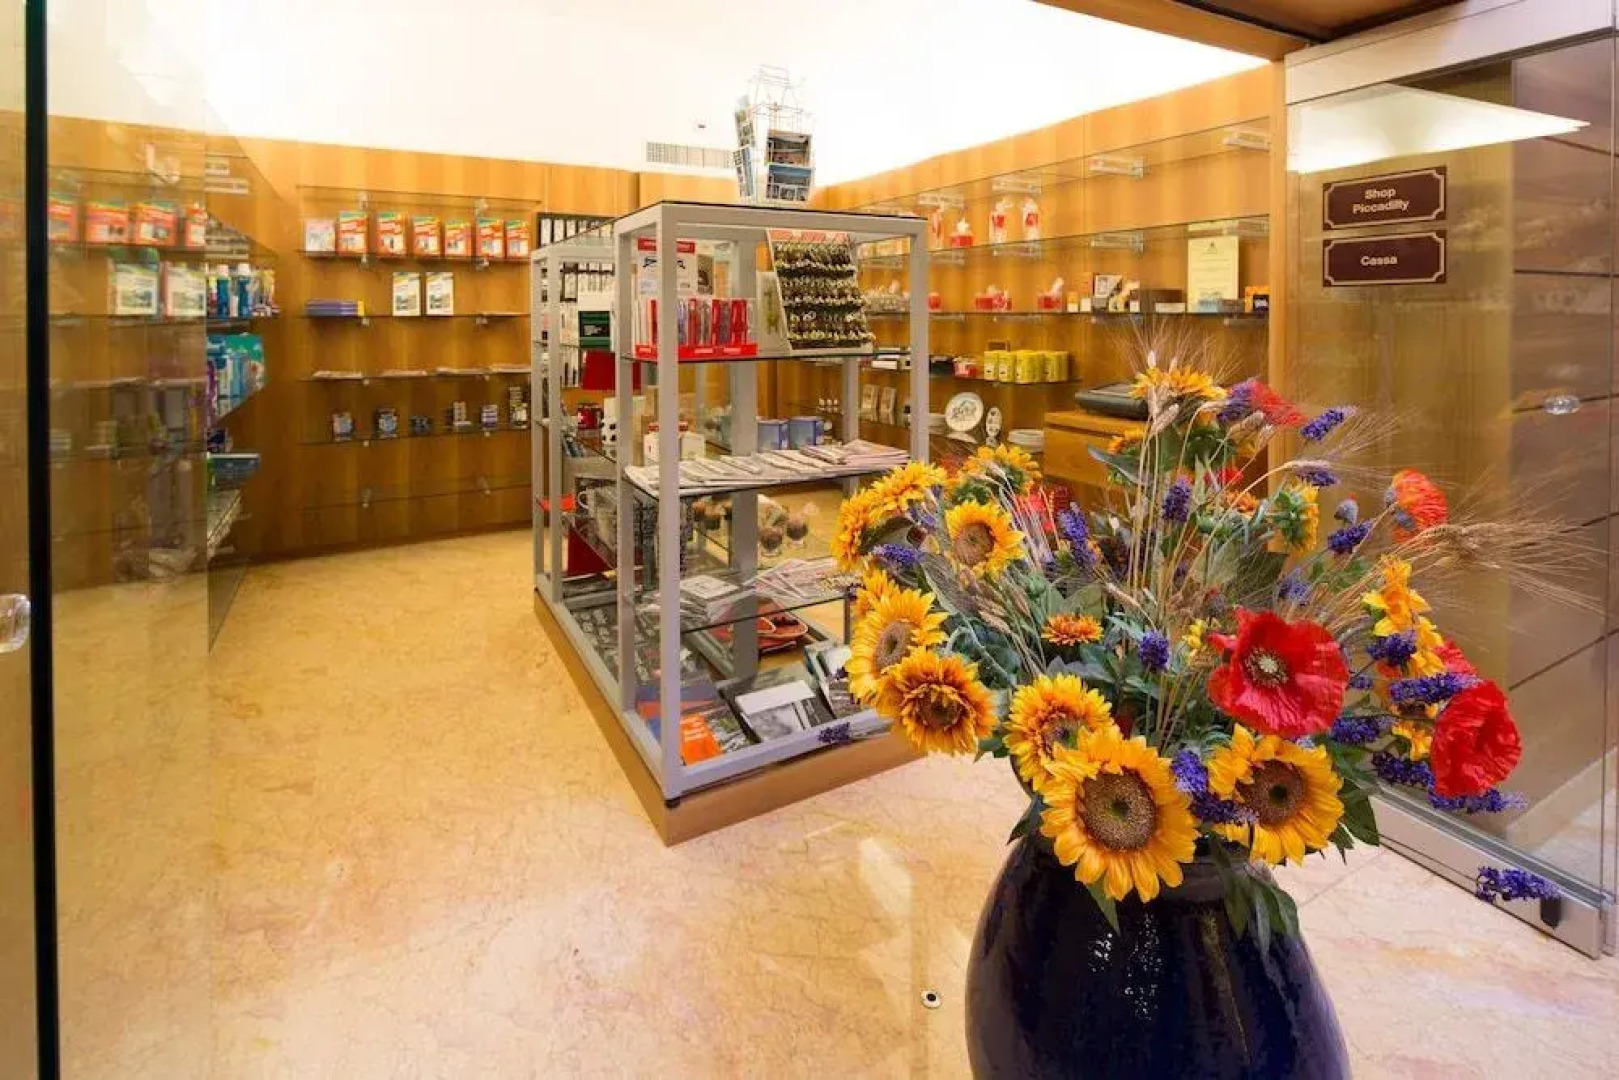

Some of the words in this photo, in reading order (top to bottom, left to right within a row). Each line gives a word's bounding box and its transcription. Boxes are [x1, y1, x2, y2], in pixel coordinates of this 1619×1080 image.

[1364, 188, 1396, 200] Shop
[1352, 199, 1410, 214] Piccadilly
[1361, 255, 1398, 267] Cassa
